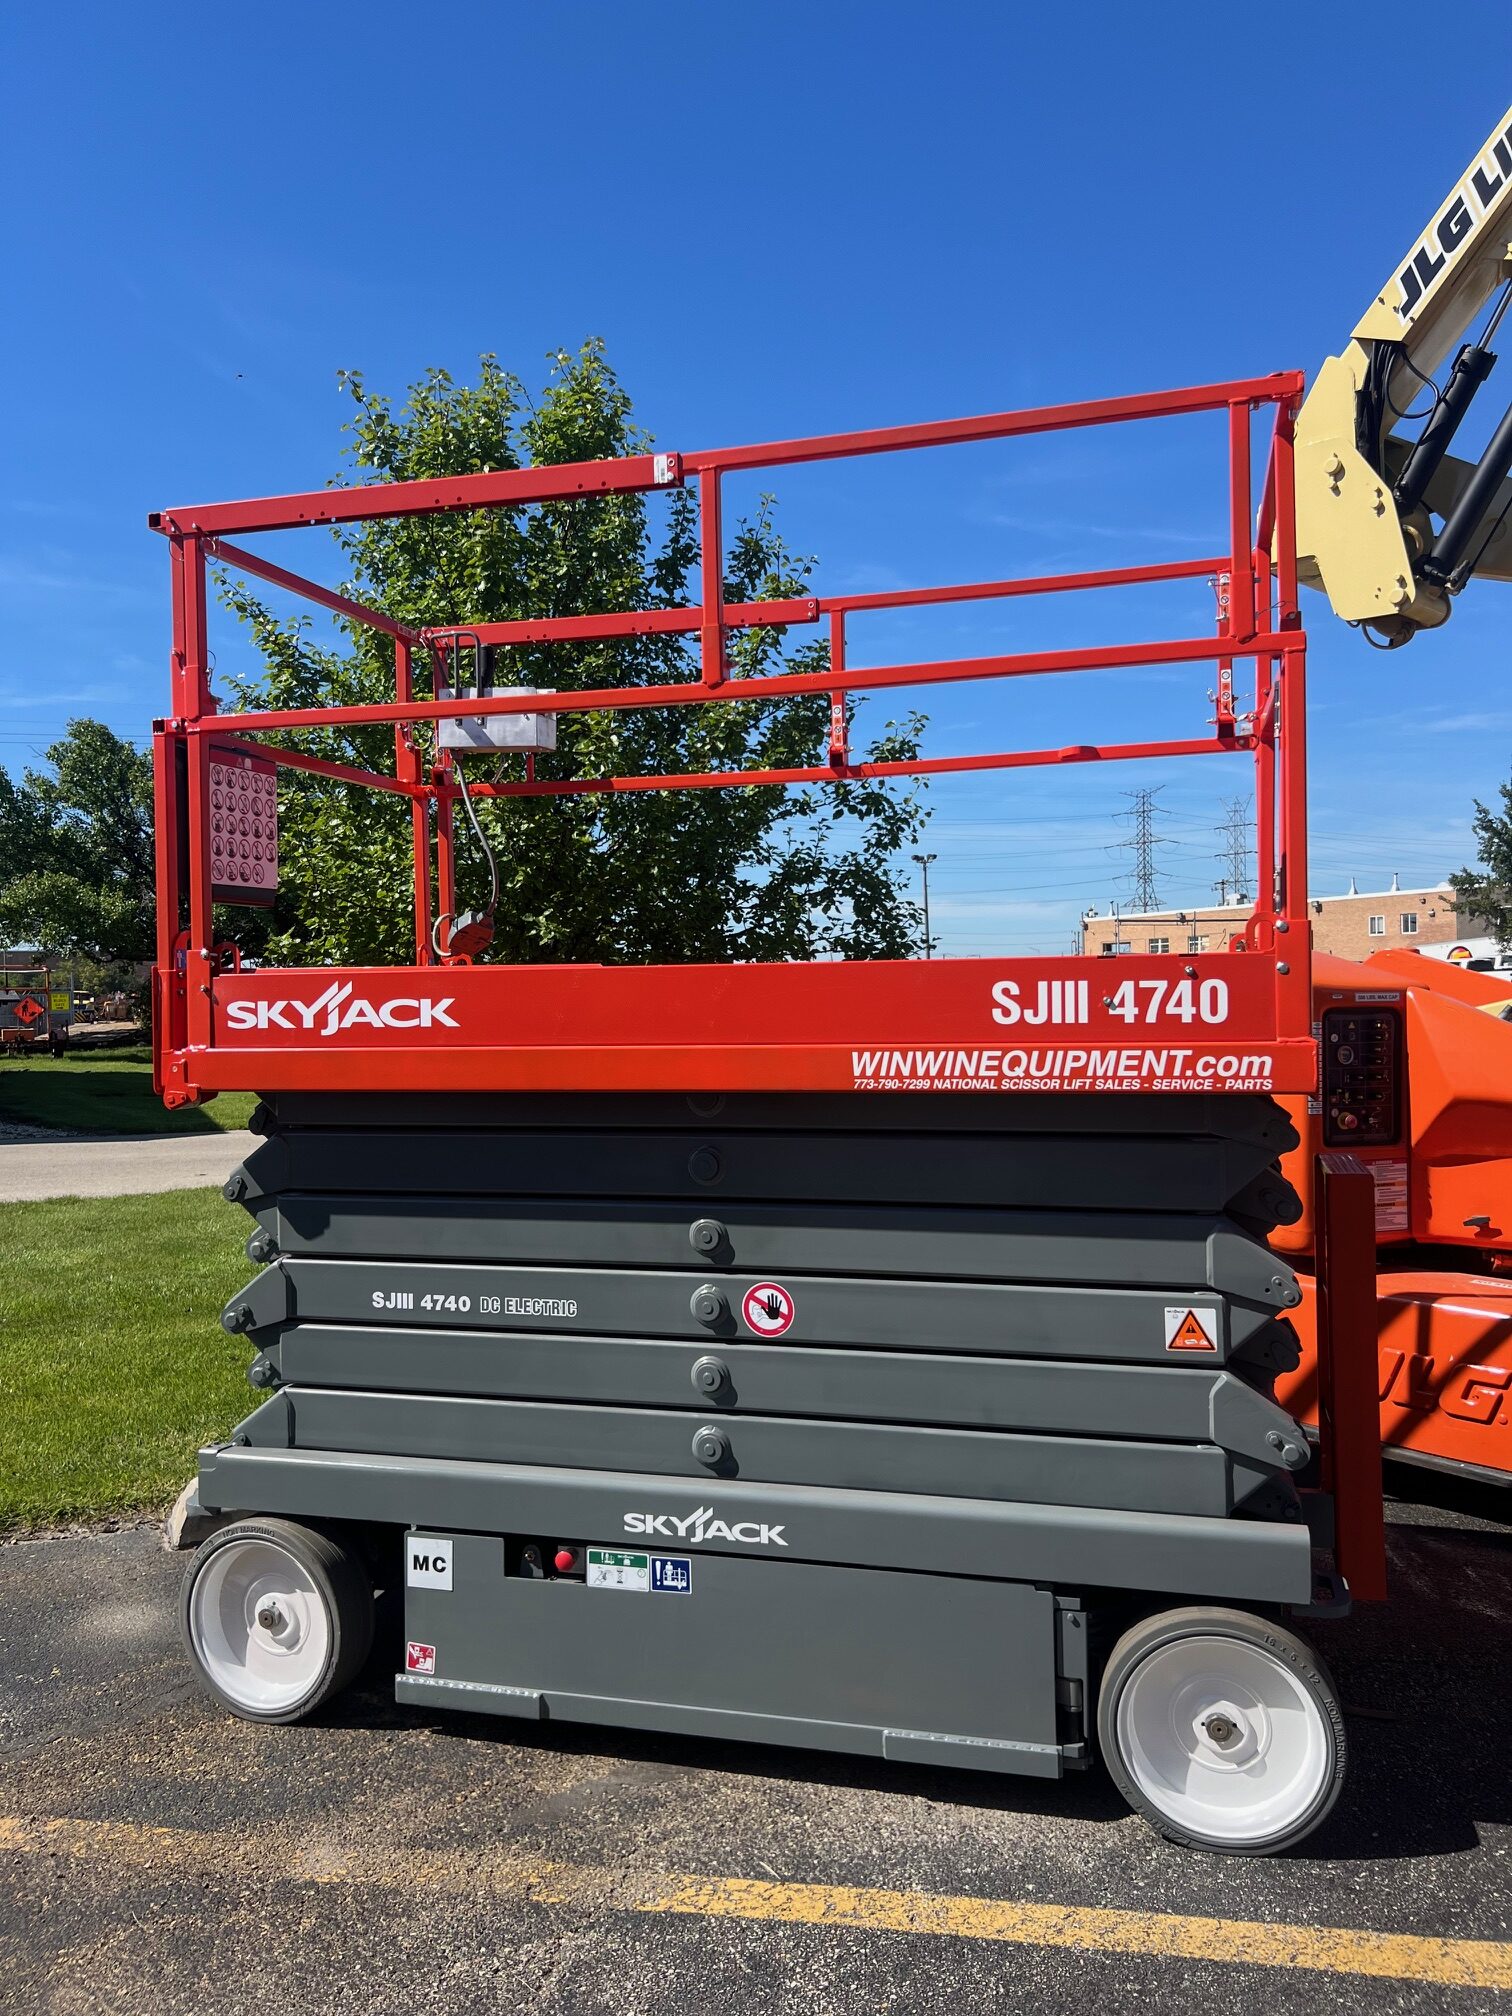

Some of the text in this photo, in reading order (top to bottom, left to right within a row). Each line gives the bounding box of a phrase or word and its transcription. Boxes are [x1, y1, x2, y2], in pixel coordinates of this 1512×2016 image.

[1400, 122, 1512, 320] JLG LI
[226, 980, 461, 1036] SKYJACK
[991, 978, 1229, 1025] SJIII 4740
[851, 1049, 1273, 1078] WINWINEQUIPMENT.com
[853, 1078, 931, 1090] 773-790-7299
[933, 1078, 998, 1090] NATIONAL
[1000, 1078, 1060, 1090] SCISSOR
[1063, 1078, 1092, 1090] LIFT
[1094, 1078, 1141, 1090] SALES
[1152, 1078, 1213, 1090] SERVICE
[1224, 1078, 1273, 1090] PARTS
[372, 1291, 578, 1318] SJIII 4740 DC ELECTRIC
[622, 1505, 789, 1547] SKYJACK
[1324, 1698, 1342, 1723] NON
